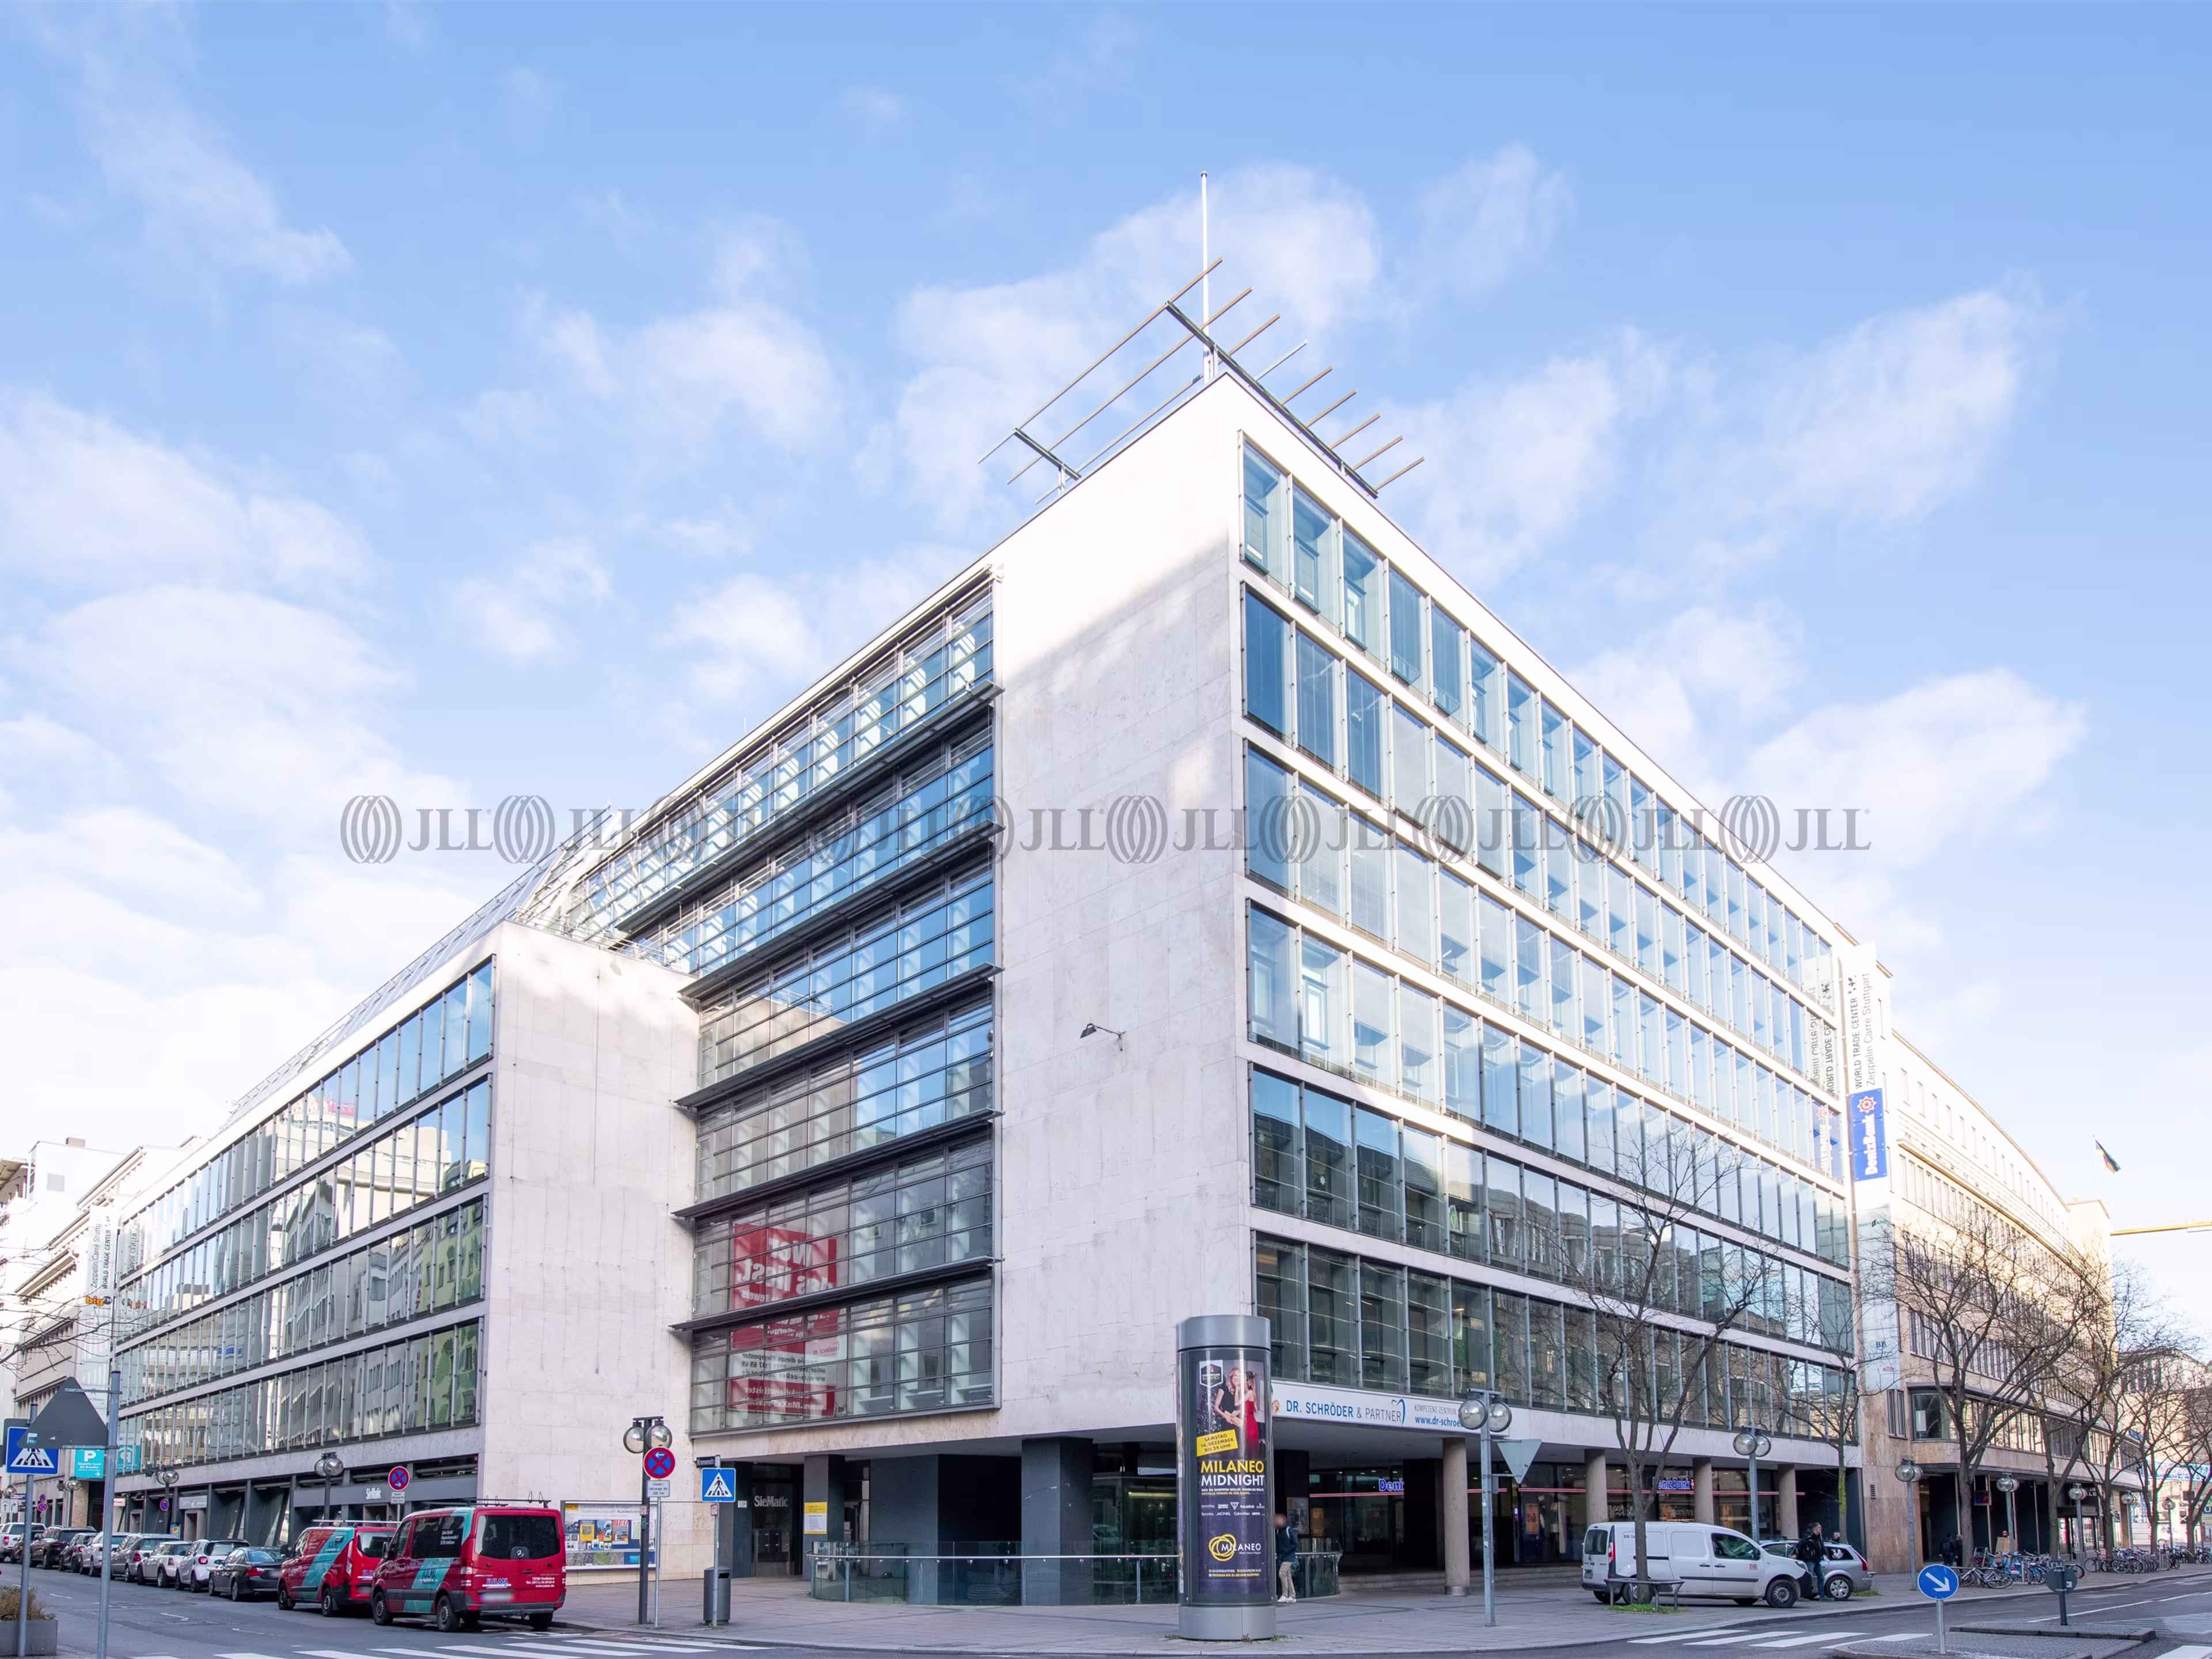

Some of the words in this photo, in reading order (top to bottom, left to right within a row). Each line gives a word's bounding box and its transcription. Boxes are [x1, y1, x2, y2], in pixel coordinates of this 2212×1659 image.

[1862, 972, 1872, 1016] Stuttgart
[1850, 997, 1859, 1029] CENTER
[1863, 1018, 1873, 1043] Carré
[1866, 1046, 1876, 1086] Zeppelin
[1854, 1060, 1862, 1089] WORLD
[1862, 1113, 1878, 1175] DenizBank
[86, 1296, 104, 1306] big
[1286, 1400, 1302, 1413] DR.
[1305, 1402, 1354, 1418] SCHRÖDER
[1357, 1407, 1362, 1418] &
[1365, 1408, 1402, 1422] PARTNER
[1204, 1433, 1228, 1442] SAMSTAG
[1209, 1438, 1234, 1446] DEZEMBER
[84, 1450, 96, 1462] P
[1200, 1460, 1264, 1473] MILANEO
[1201, 1474, 1264, 1486] MIDNIGHT
[1378, 1478, 1404, 1491] Deni
[754, 1495, 788, 1507] SieMatic
